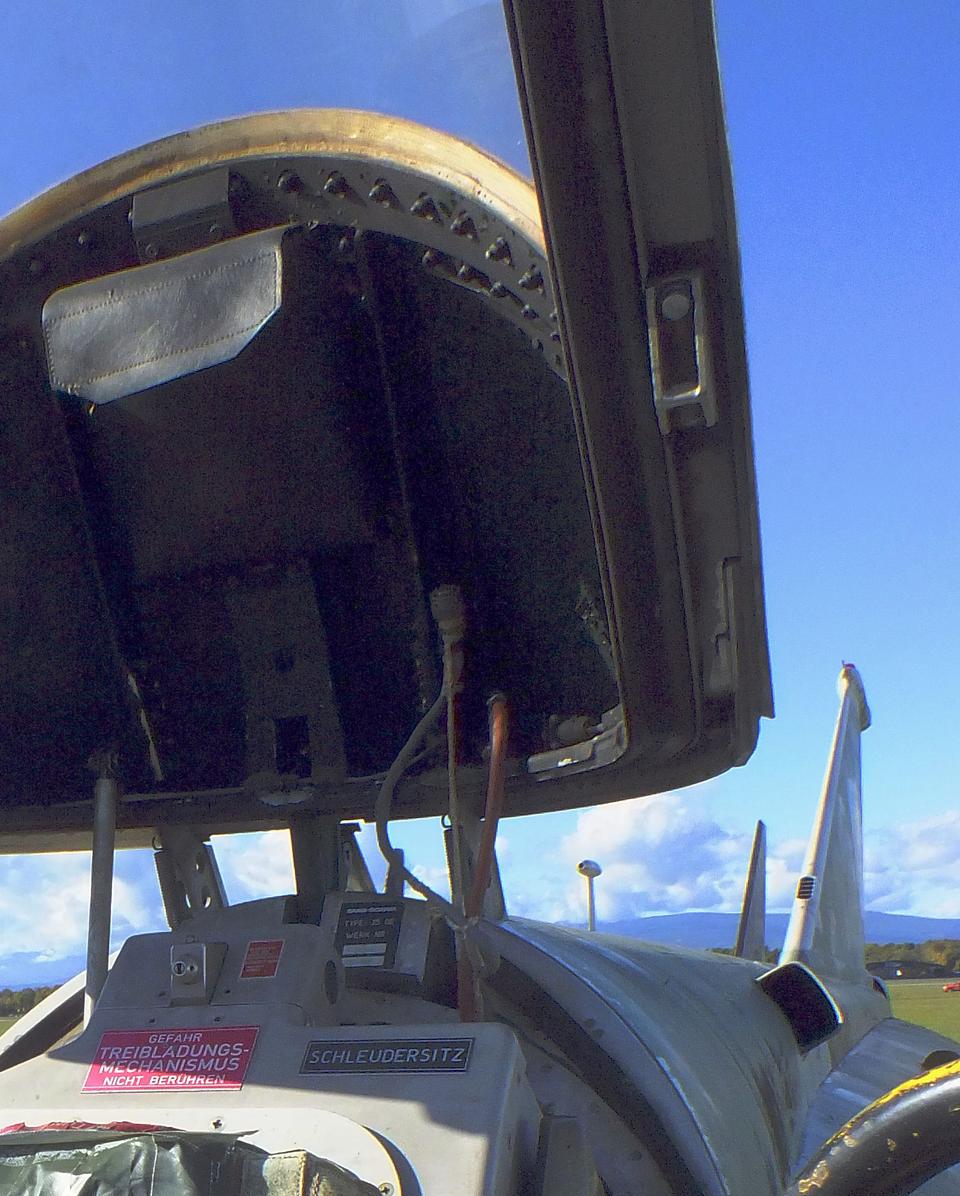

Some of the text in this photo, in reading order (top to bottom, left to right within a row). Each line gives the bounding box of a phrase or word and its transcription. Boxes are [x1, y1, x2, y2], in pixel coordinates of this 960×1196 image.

[148, 1033, 203, 1044] GEFAHR
[99, 1043, 250, 1060] TREIBLADUNGS-
[308, 1048, 466, 1064] SCHLEUDERSITZ
[98, 1057, 240, 1074] MECHANISMUS
[102, 1073, 226, 1086] NICHT BERÜHREN
